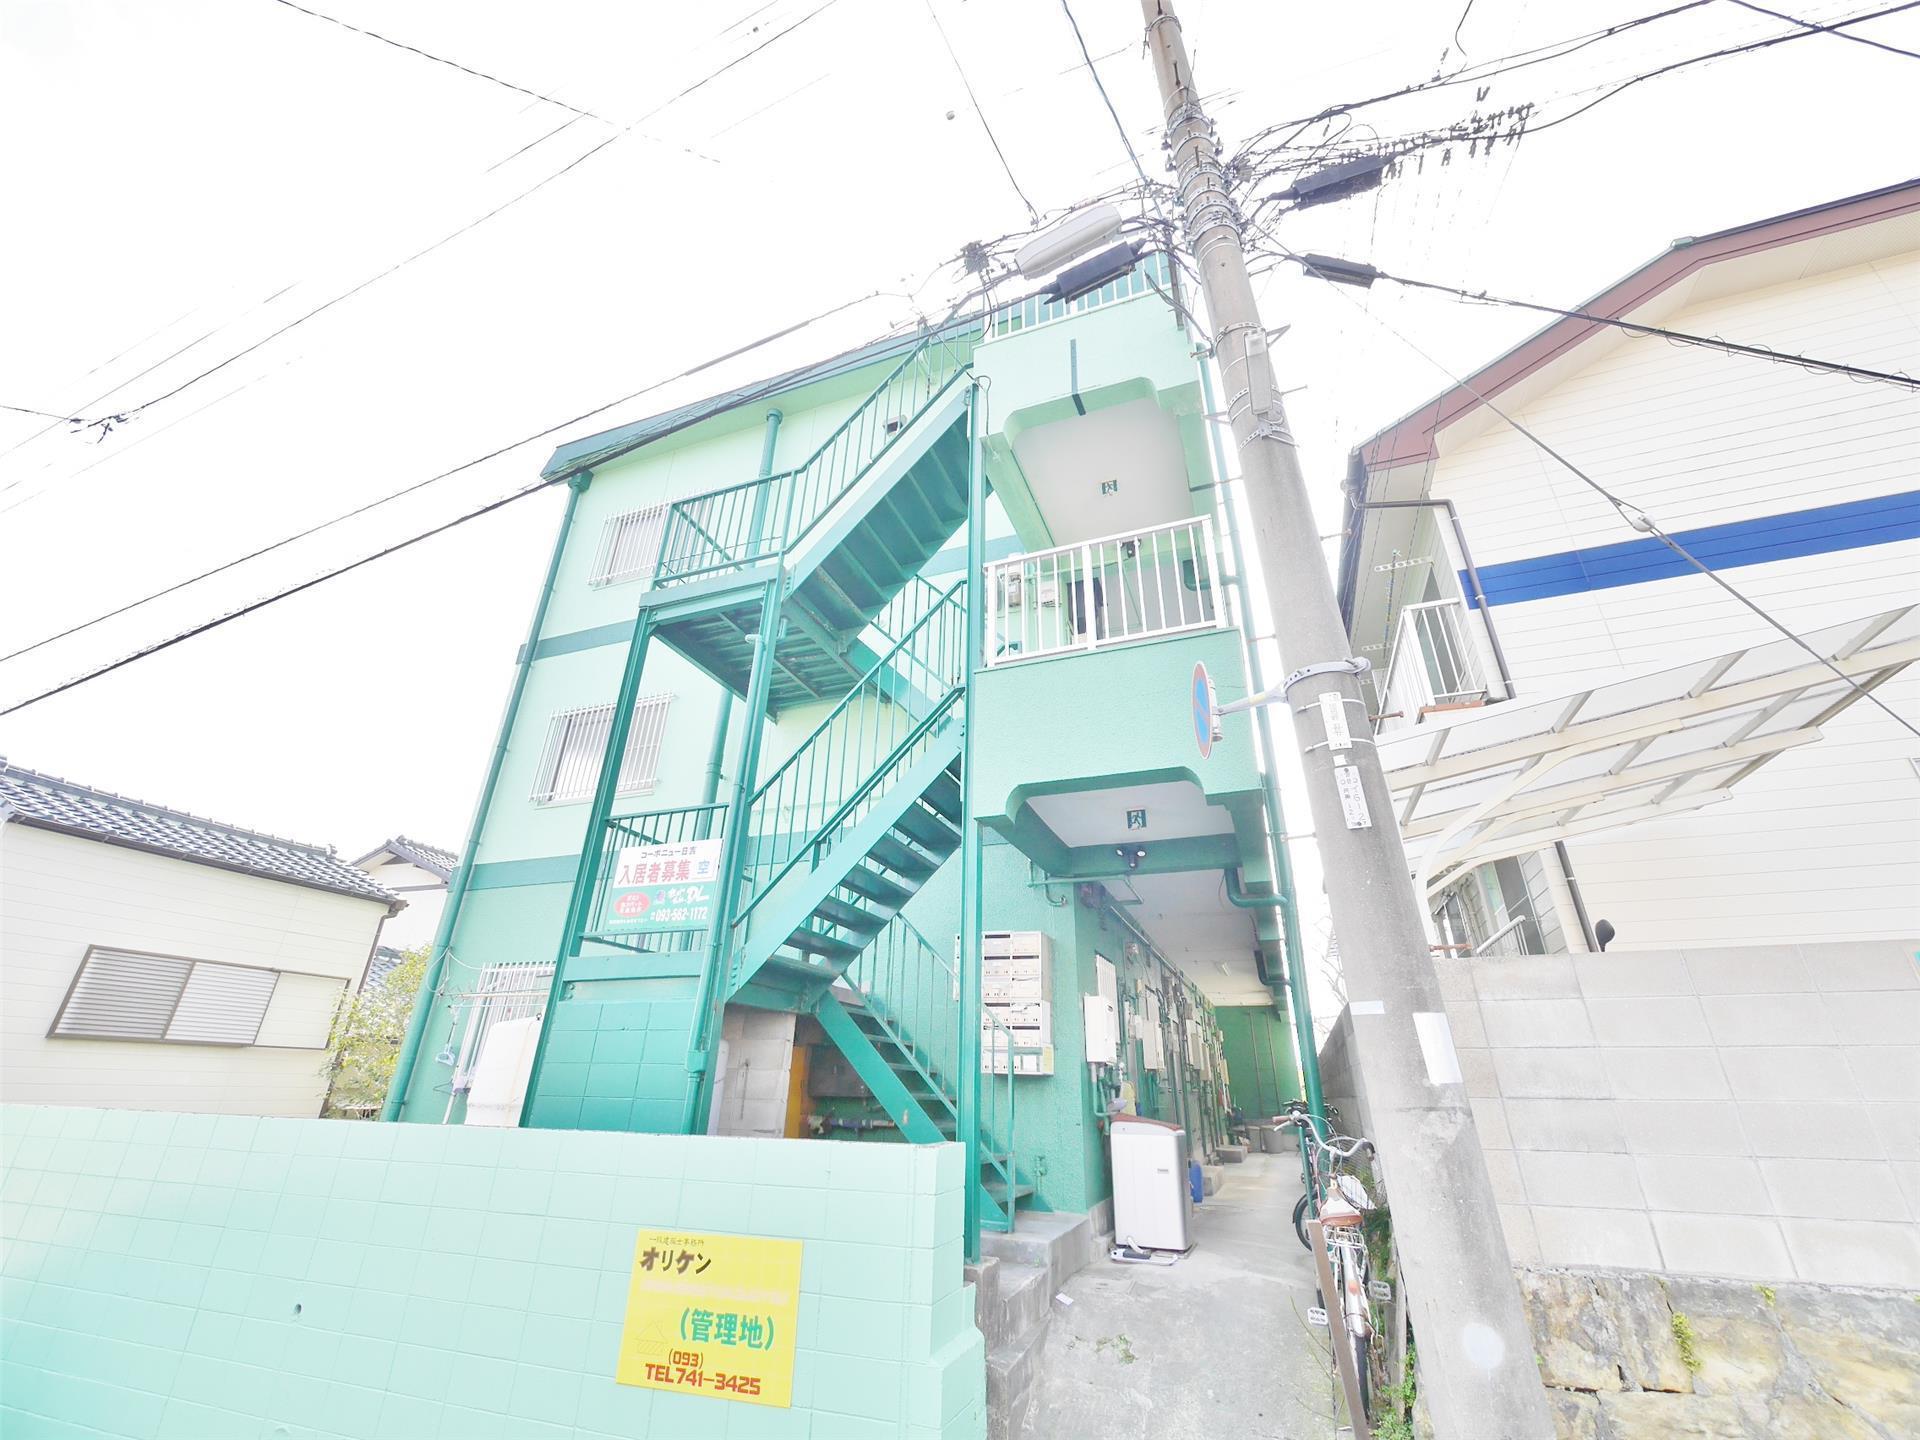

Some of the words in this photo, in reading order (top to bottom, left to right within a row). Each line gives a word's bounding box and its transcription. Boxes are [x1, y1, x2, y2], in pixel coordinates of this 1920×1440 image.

[617, 859, 691, 885] 入居者募集
[697, 858, 711, 875] 空
[640, 1246, 712, 1274] オリケン
[668, 1348, 704, 1369] (093)
